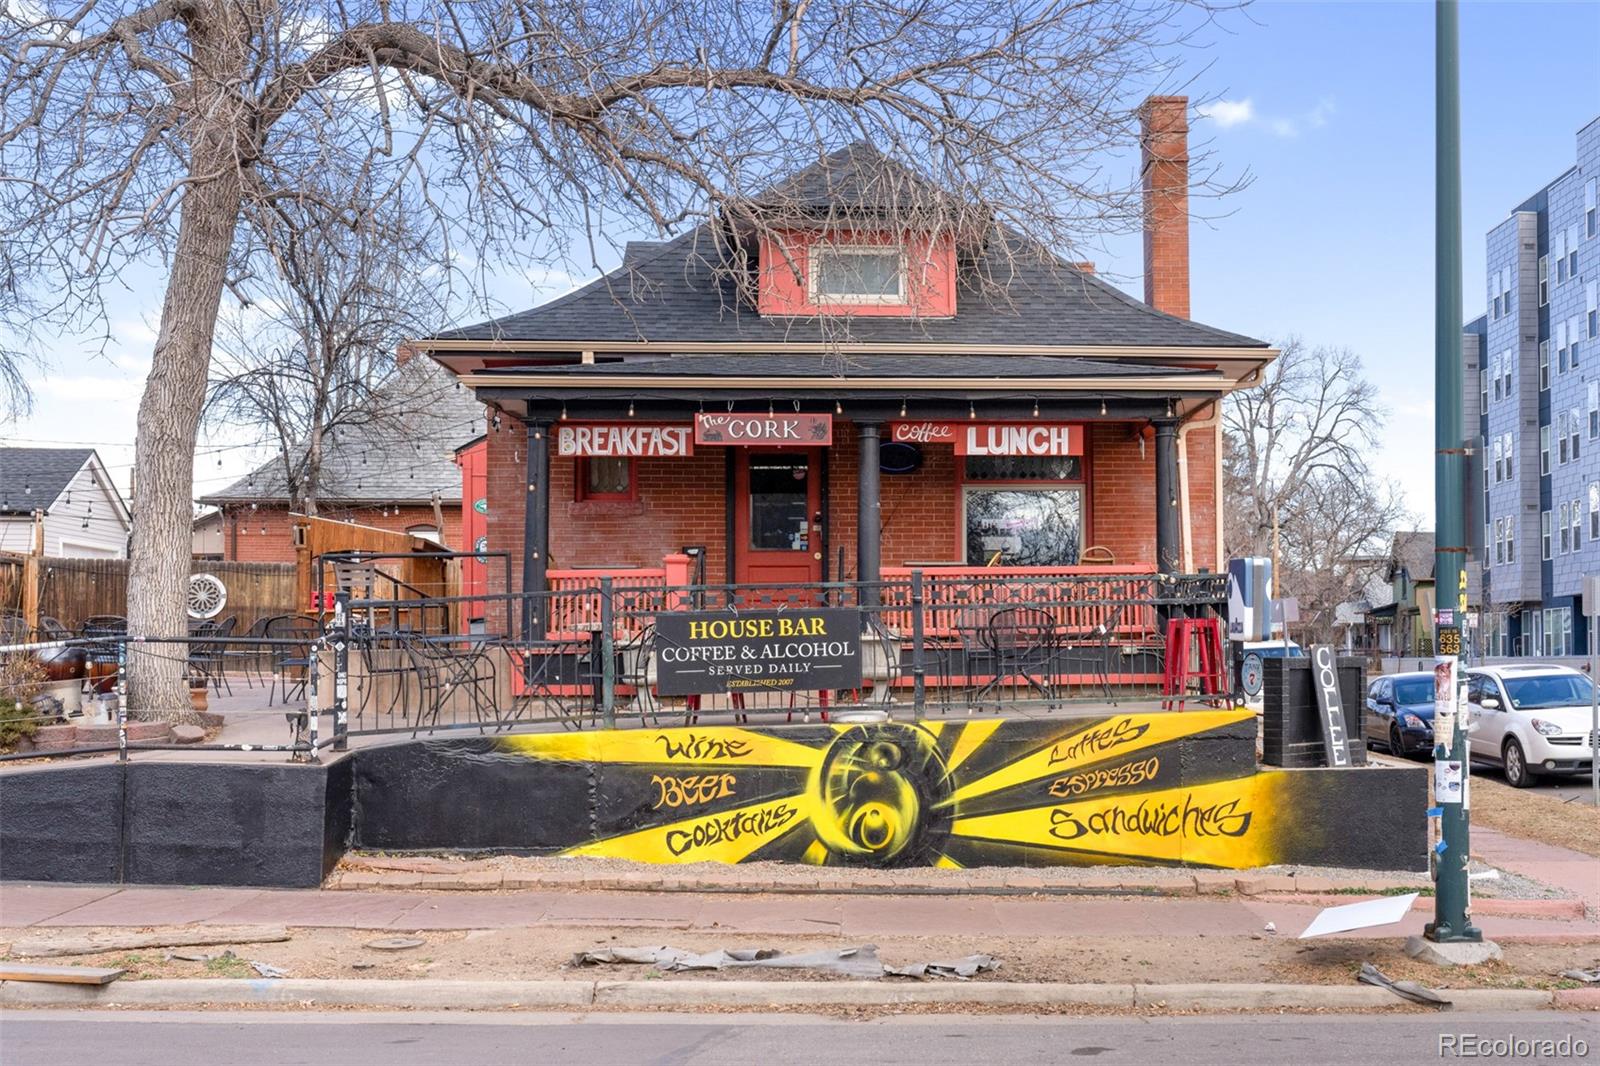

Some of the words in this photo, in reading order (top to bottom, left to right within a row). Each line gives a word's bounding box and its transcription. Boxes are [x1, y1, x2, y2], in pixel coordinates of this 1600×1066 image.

[699, 414, 731, 429] The
[728, 419, 801, 440] CORK
[558, 426, 692, 457] BREAKFAST
[896, 422, 953, 443] Coffee
[966, 426, 1069, 456] LUNCH
[689, 619, 774, 640] HOUSE
[777, 617, 827, 637] BAR
[1440, 633, 1461, 644] 635
[662, 645, 736, 663] COFFEE
[741, 646, 757, 660] &
[760, 641, 855, 660] ALCOHOL
[1440, 644, 1461, 655] 563
[708, 665, 763, 676] SERVED
[769, 662, 812, 674] DAILY
[666, 804, 798, 857] Cocktails
